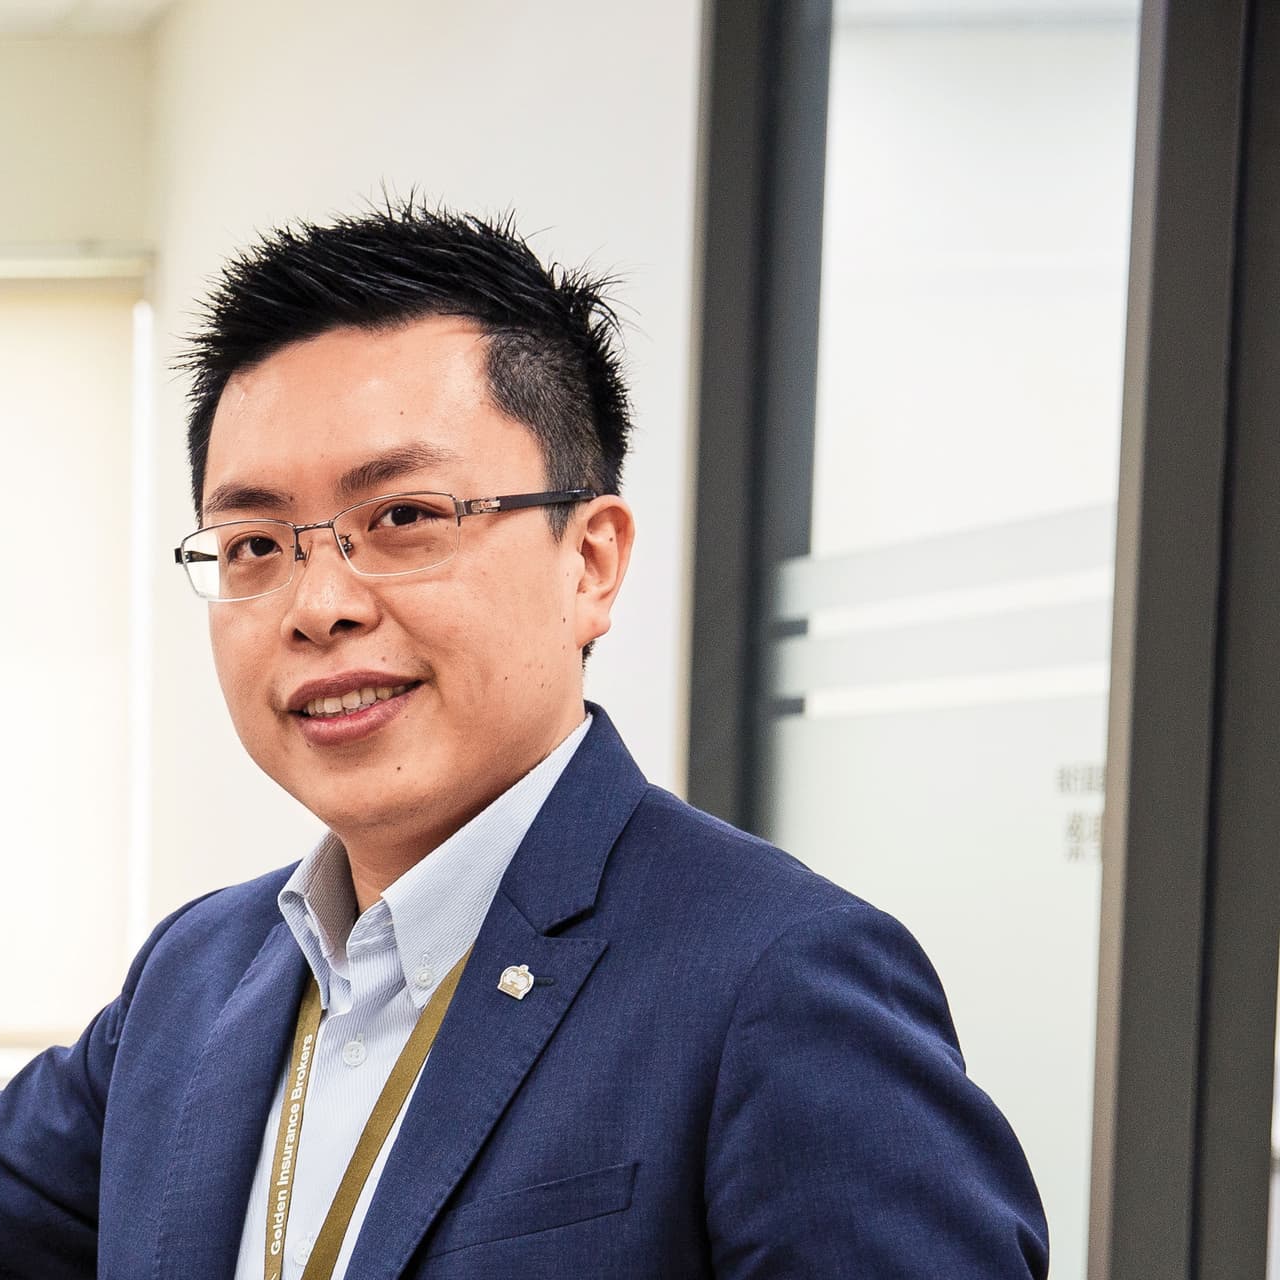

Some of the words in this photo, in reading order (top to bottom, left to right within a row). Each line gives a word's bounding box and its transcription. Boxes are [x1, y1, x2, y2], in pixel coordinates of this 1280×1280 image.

[291, 1033, 313, 1099] Brokers
[276, 1103, 300, 1187] Insurance
[270, 1189, 288, 1256] Golden
